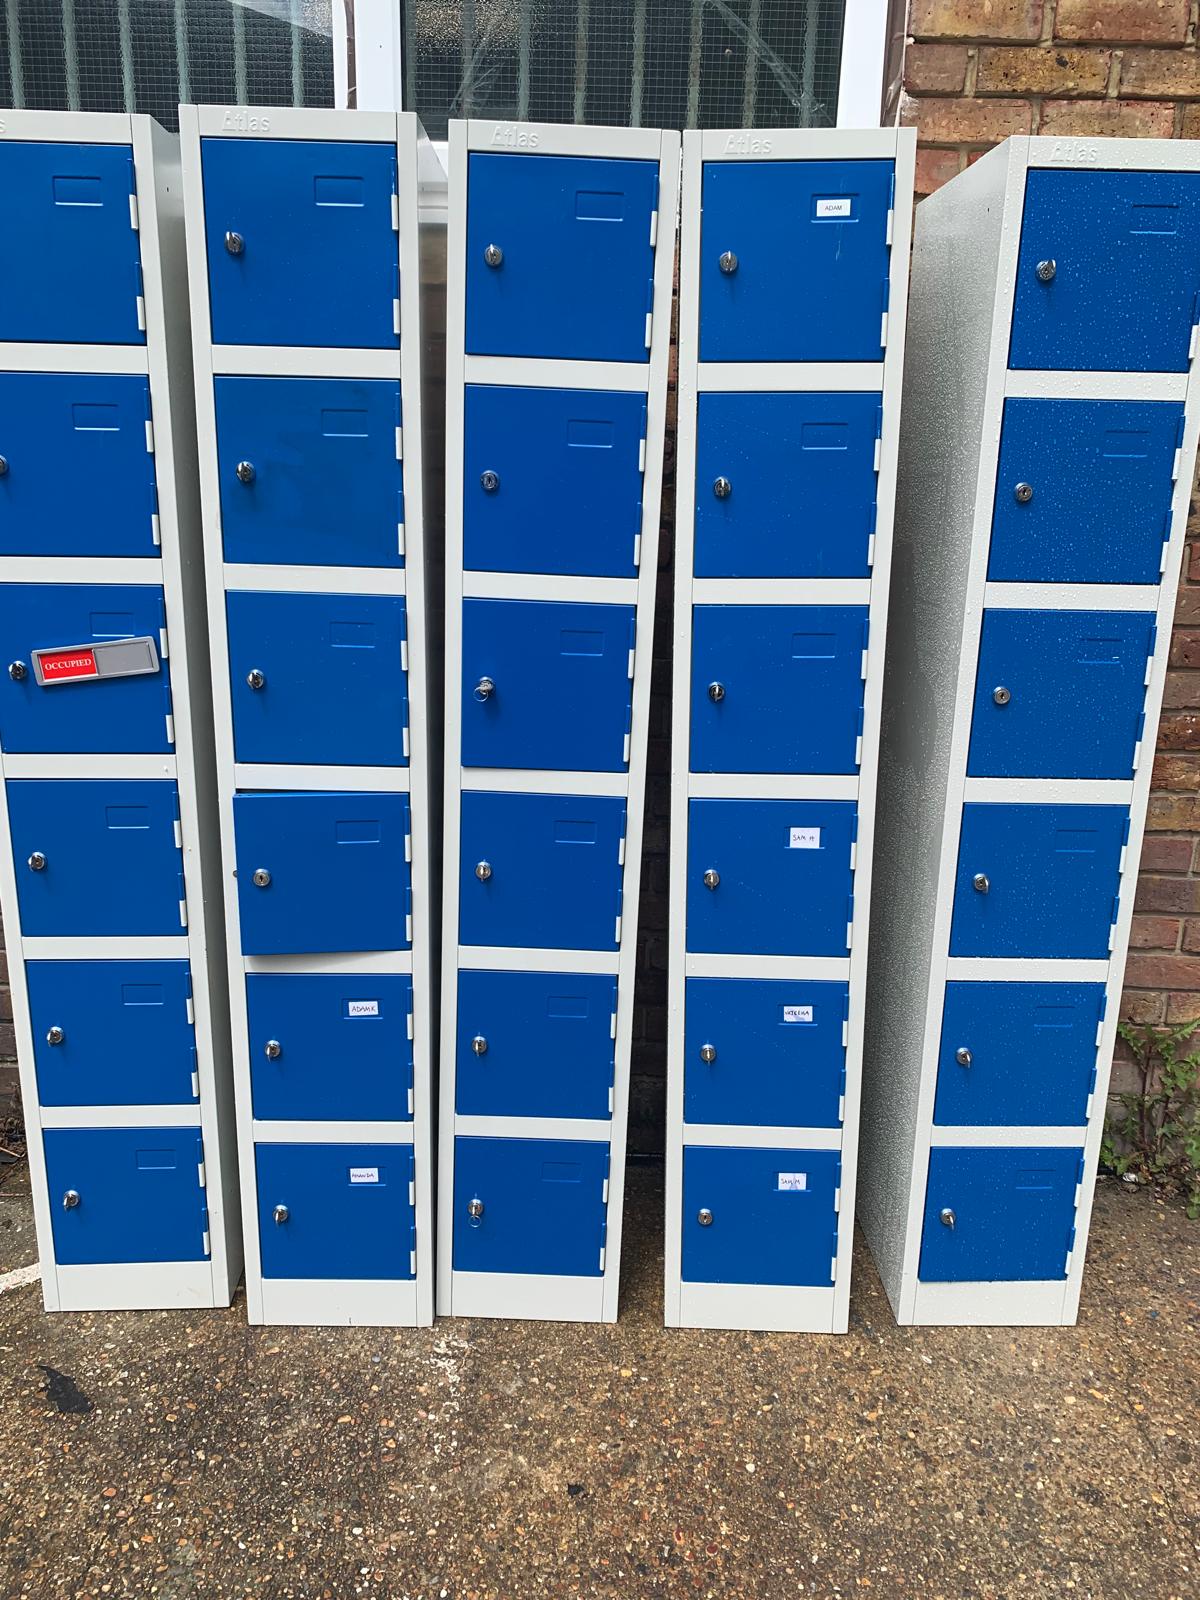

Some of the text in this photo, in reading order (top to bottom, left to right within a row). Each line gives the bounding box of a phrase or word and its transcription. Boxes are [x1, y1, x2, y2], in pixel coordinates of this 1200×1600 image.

[222, 110, 271, 132] Atlas
[490, 125, 540, 149] Atlas
[723, 133, 773, 155] Atlas
[1049, 141, 1098, 163] Atlas
[44, 658, 92, 671] OCCUPIED
[792, 834, 806, 842] SAM
